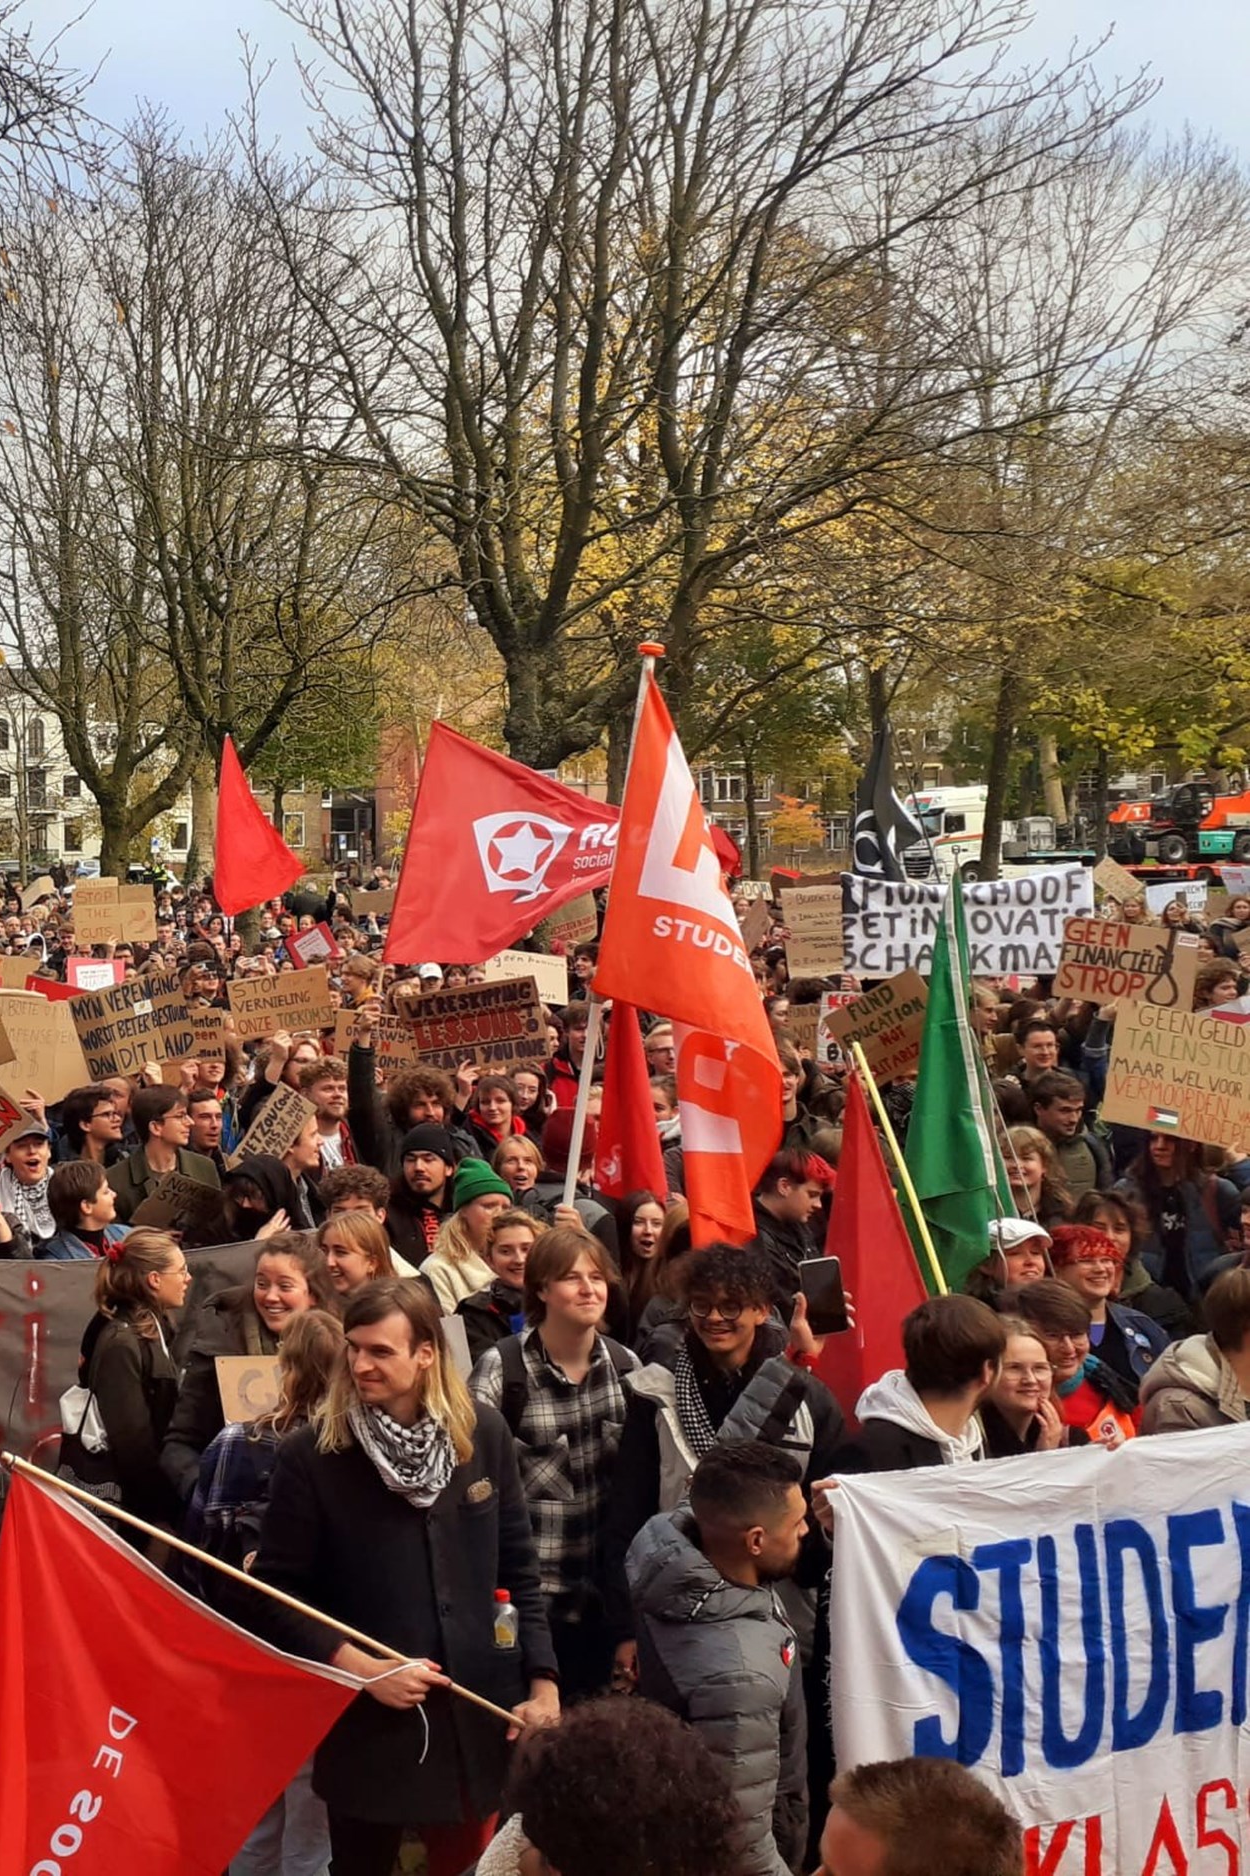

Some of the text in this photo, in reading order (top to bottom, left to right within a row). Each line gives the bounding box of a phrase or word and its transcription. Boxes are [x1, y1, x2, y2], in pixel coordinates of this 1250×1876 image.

[861, 880, 940, 910] PION
[84, 908, 111, 919] THE
[1065, 918, 1131, 949] GEEN
[232, 975, 280, 1000] STOP
[1060, 963, 1146, 999] STROP
[233, 990, 311, 1014] VERNIELING
[846, 984, 895, 1023] FUND
[116, 1013, 151, 1039] BETER
[194, 1030, 218, 1041] een
[238, 1015, 273, 1035] ONZE
[412, 1006, 524, 1050] LESSONS
[842, 995, 927, 1049] EDUCATION
[877, 1024, 907, 1047] NOT
[1138, 1005, 1247, 1048] GEEN GELD
[88, 1052, 118, 1076] DAN
[153, 1032, 195, 1061] LAND
[479, 1042, 514, 1064] YOU
[1112, 1056, 1243, 1099] MAAR WEL VOOR
[1113, 1074, 1231, 1118] VERMOORDEN
[92, 1705, 139, 1779] DE
[1023, 1777, 1250, 1876] KLAS
